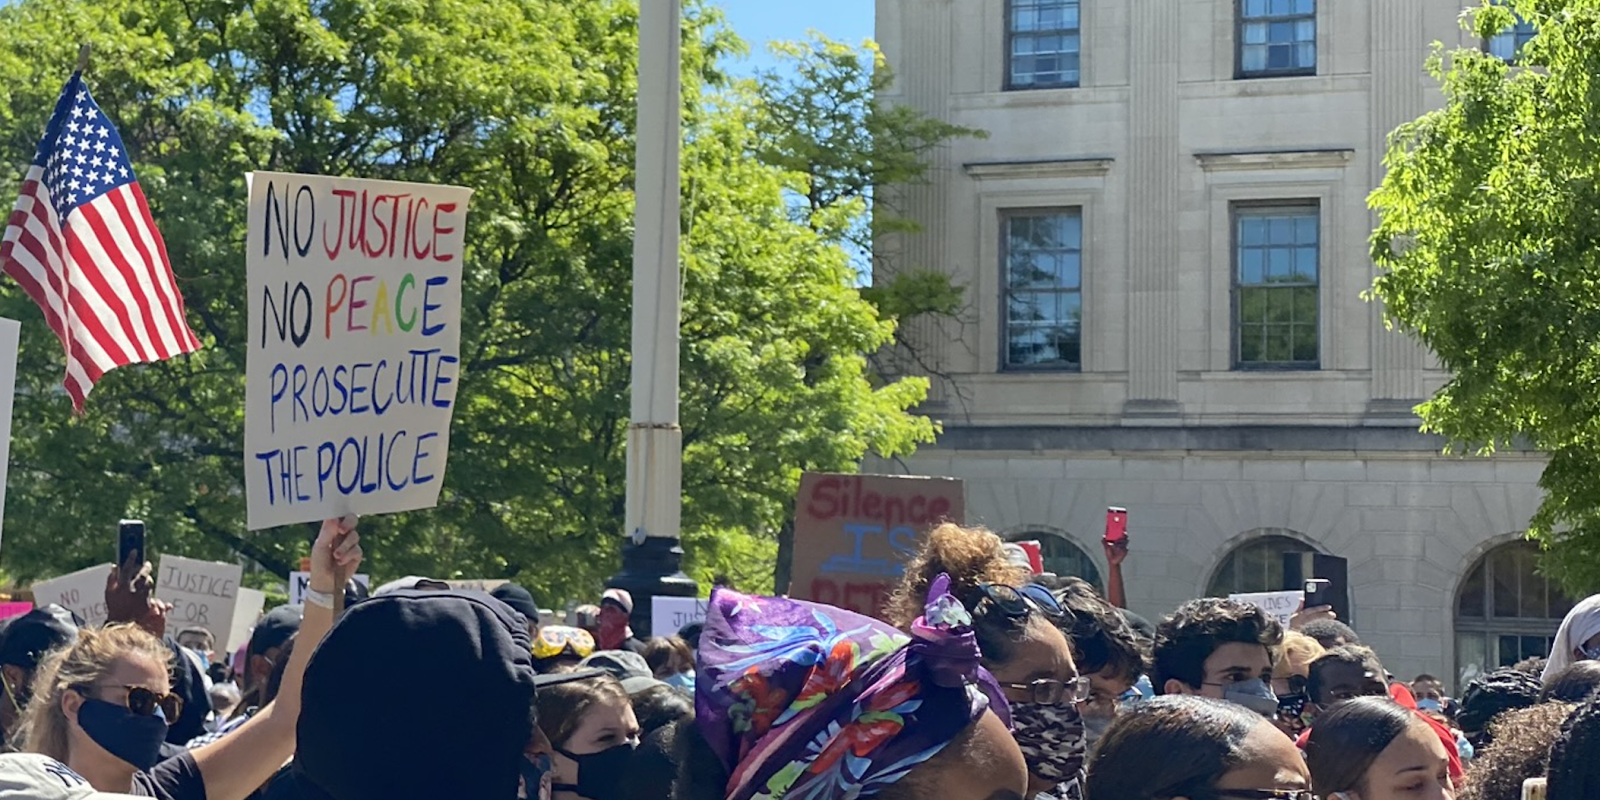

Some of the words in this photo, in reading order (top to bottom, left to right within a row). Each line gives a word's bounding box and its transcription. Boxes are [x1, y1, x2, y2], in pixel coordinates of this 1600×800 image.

[263, 180, 315, 264] NO
[322, 188, 457, 262] JUSTICE
[262, 281, 312, 349] NO
[325, 273, 448, 340] PEACE
[269, 349, 458, 433] PROSECUTE
[255, 446, 311, 505] THE
[317, 430, 438, 502] POLICE
[807, 476, 950, 527] Silence
[60, 588, 80, 605] NO
[162, 565, 234, 599] JUSTICE
[172, 598, 210, 625] FOR
